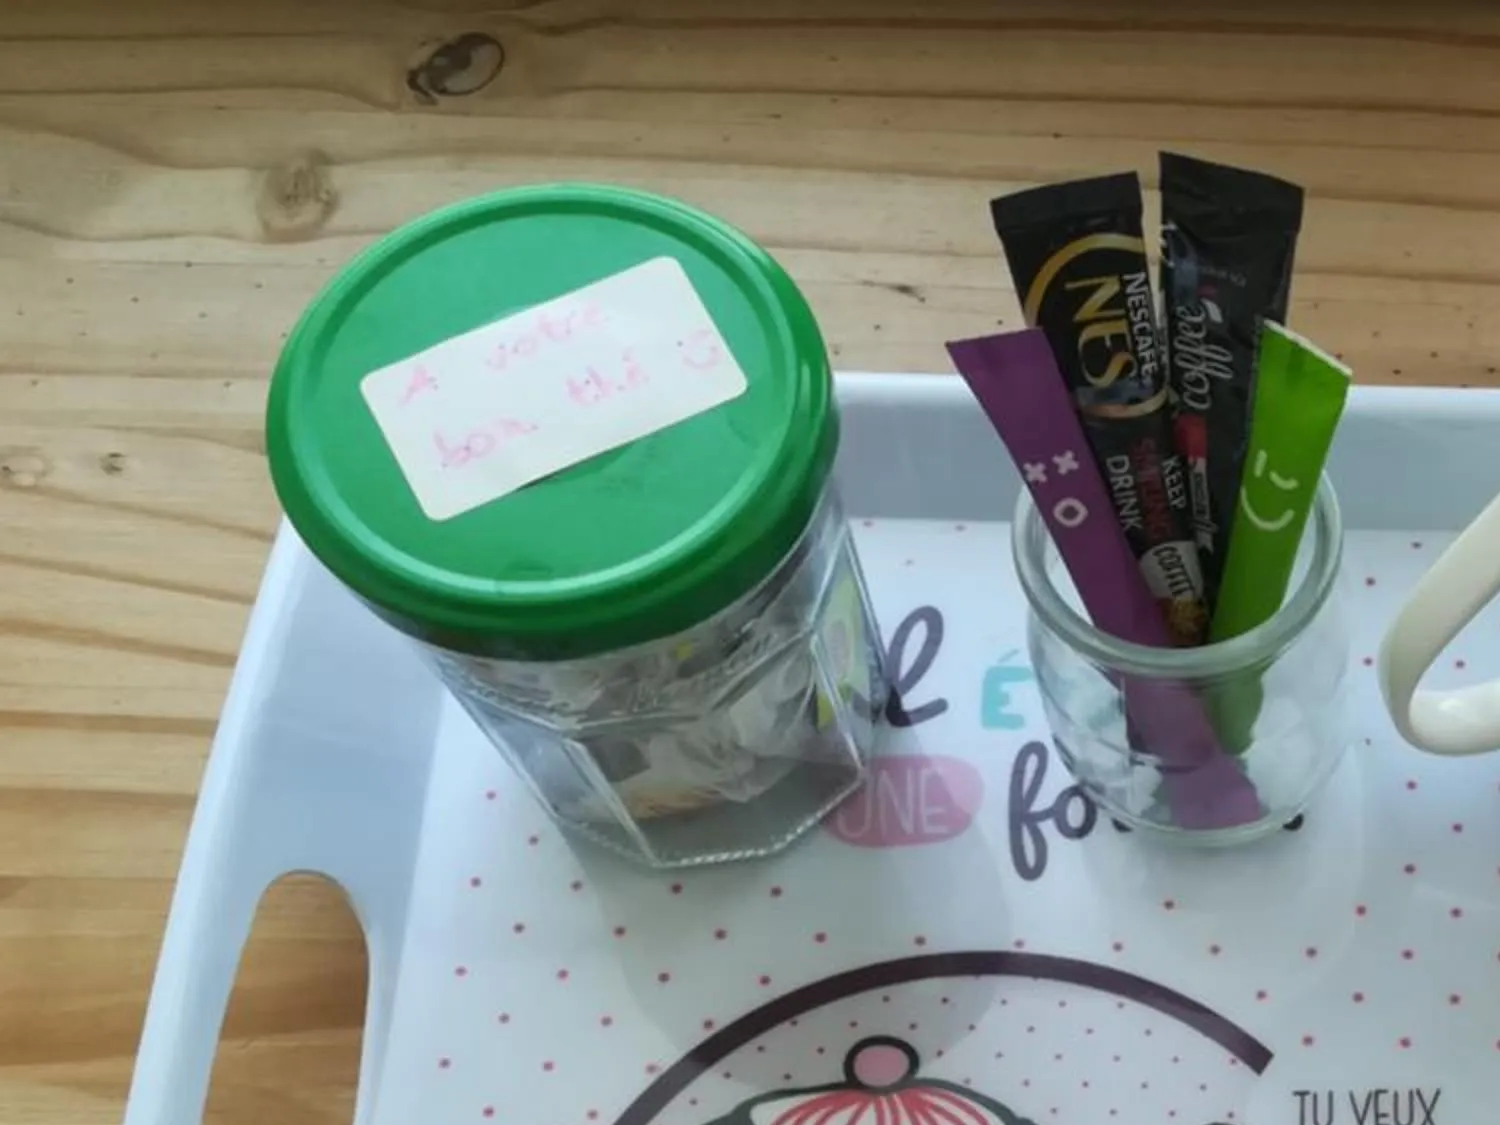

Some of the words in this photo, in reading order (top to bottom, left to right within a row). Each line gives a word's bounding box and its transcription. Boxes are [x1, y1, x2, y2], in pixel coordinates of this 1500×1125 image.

[1065, 274, 1138, 388] NES
[1173, 304, 1234, 410] coffee
[1105, 453, 1144, 532] DRINK
